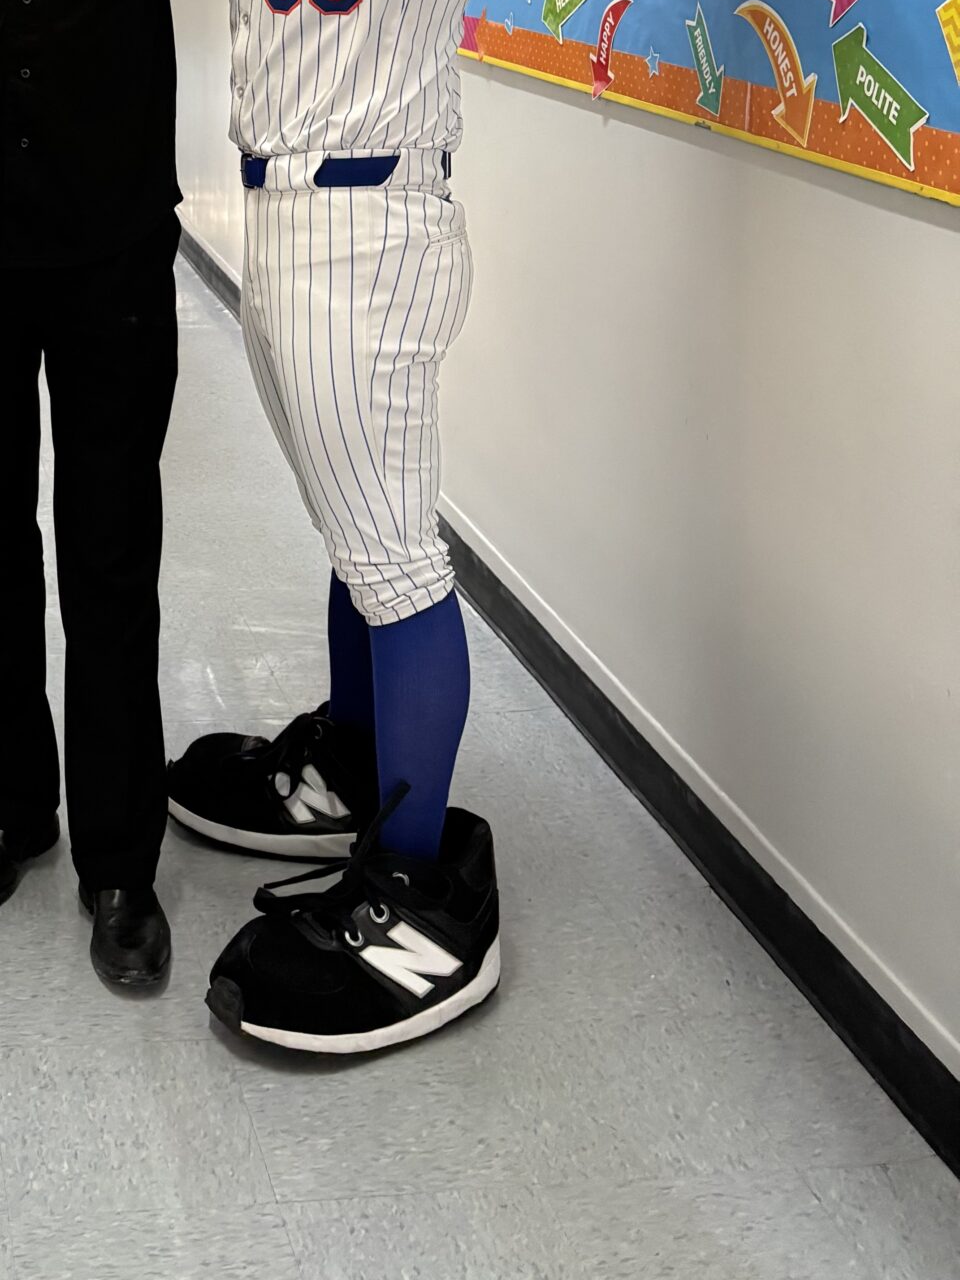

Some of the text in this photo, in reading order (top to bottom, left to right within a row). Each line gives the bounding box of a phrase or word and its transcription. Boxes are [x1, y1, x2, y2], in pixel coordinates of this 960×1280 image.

[599, 10, 616, 65] HAPPY
[693, 27, 717, 95] FRIENDLY
[763, 17, 799, 98] HONEST
[856, 64, 902, 126] POLITE
